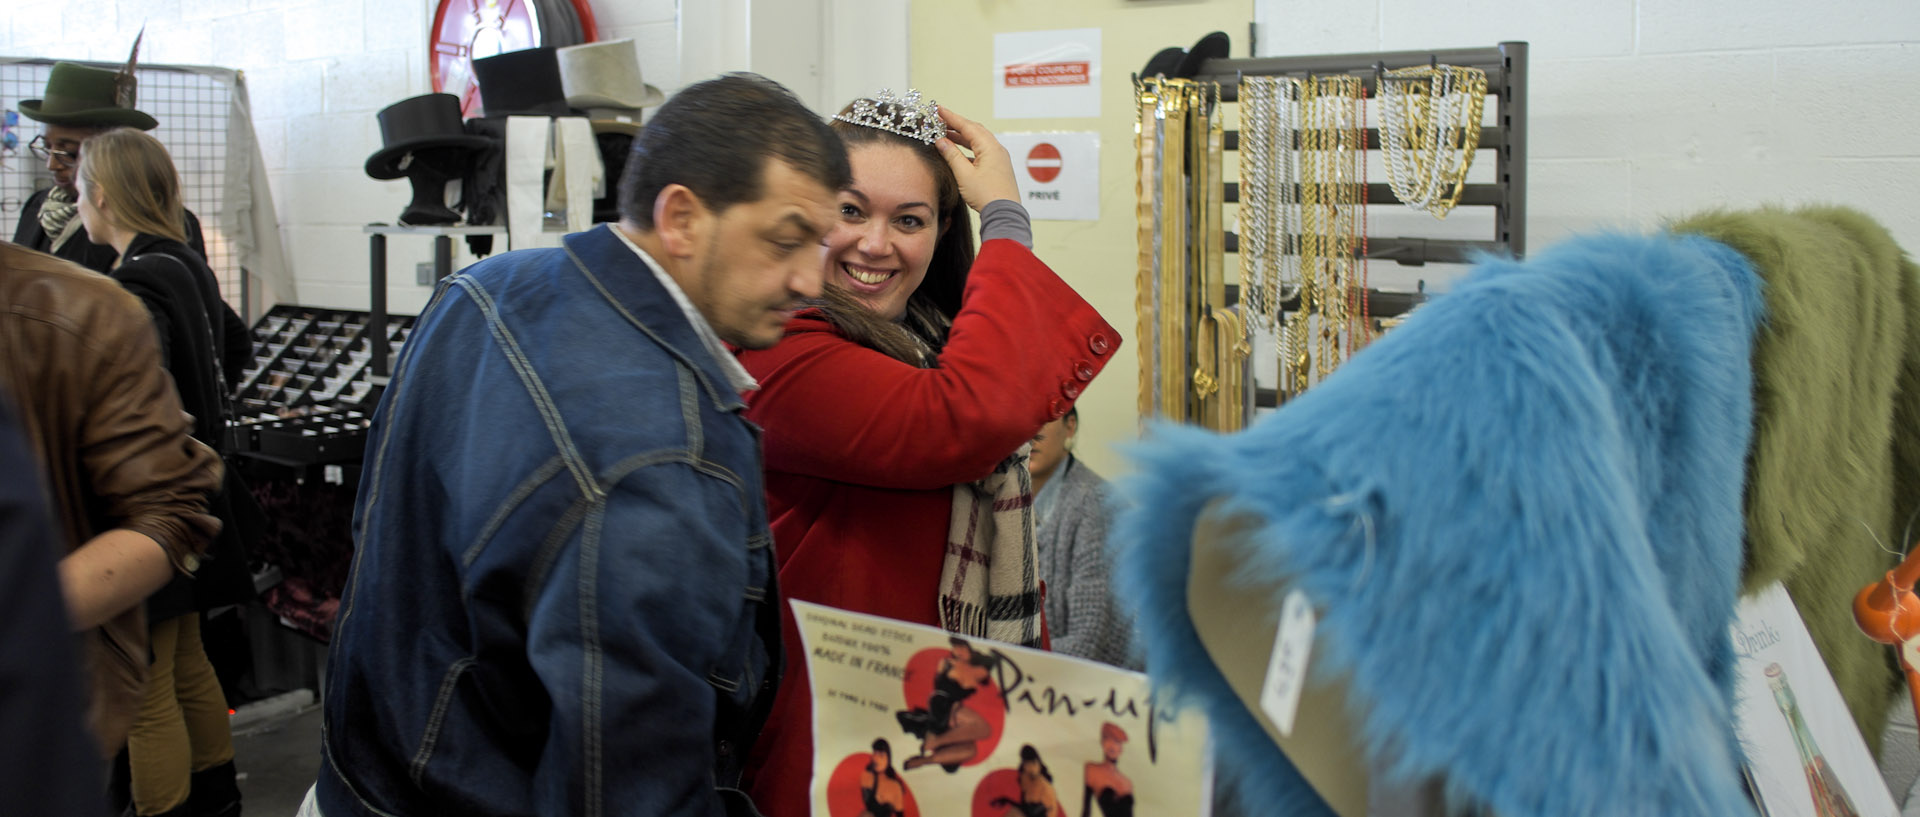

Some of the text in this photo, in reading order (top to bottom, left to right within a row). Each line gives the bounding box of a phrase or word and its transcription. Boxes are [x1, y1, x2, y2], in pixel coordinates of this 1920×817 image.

[1020, 76, 1035, 85] PAS
[814, 646, 846, 664] MADE
[849, 655, 865, 669] IN
